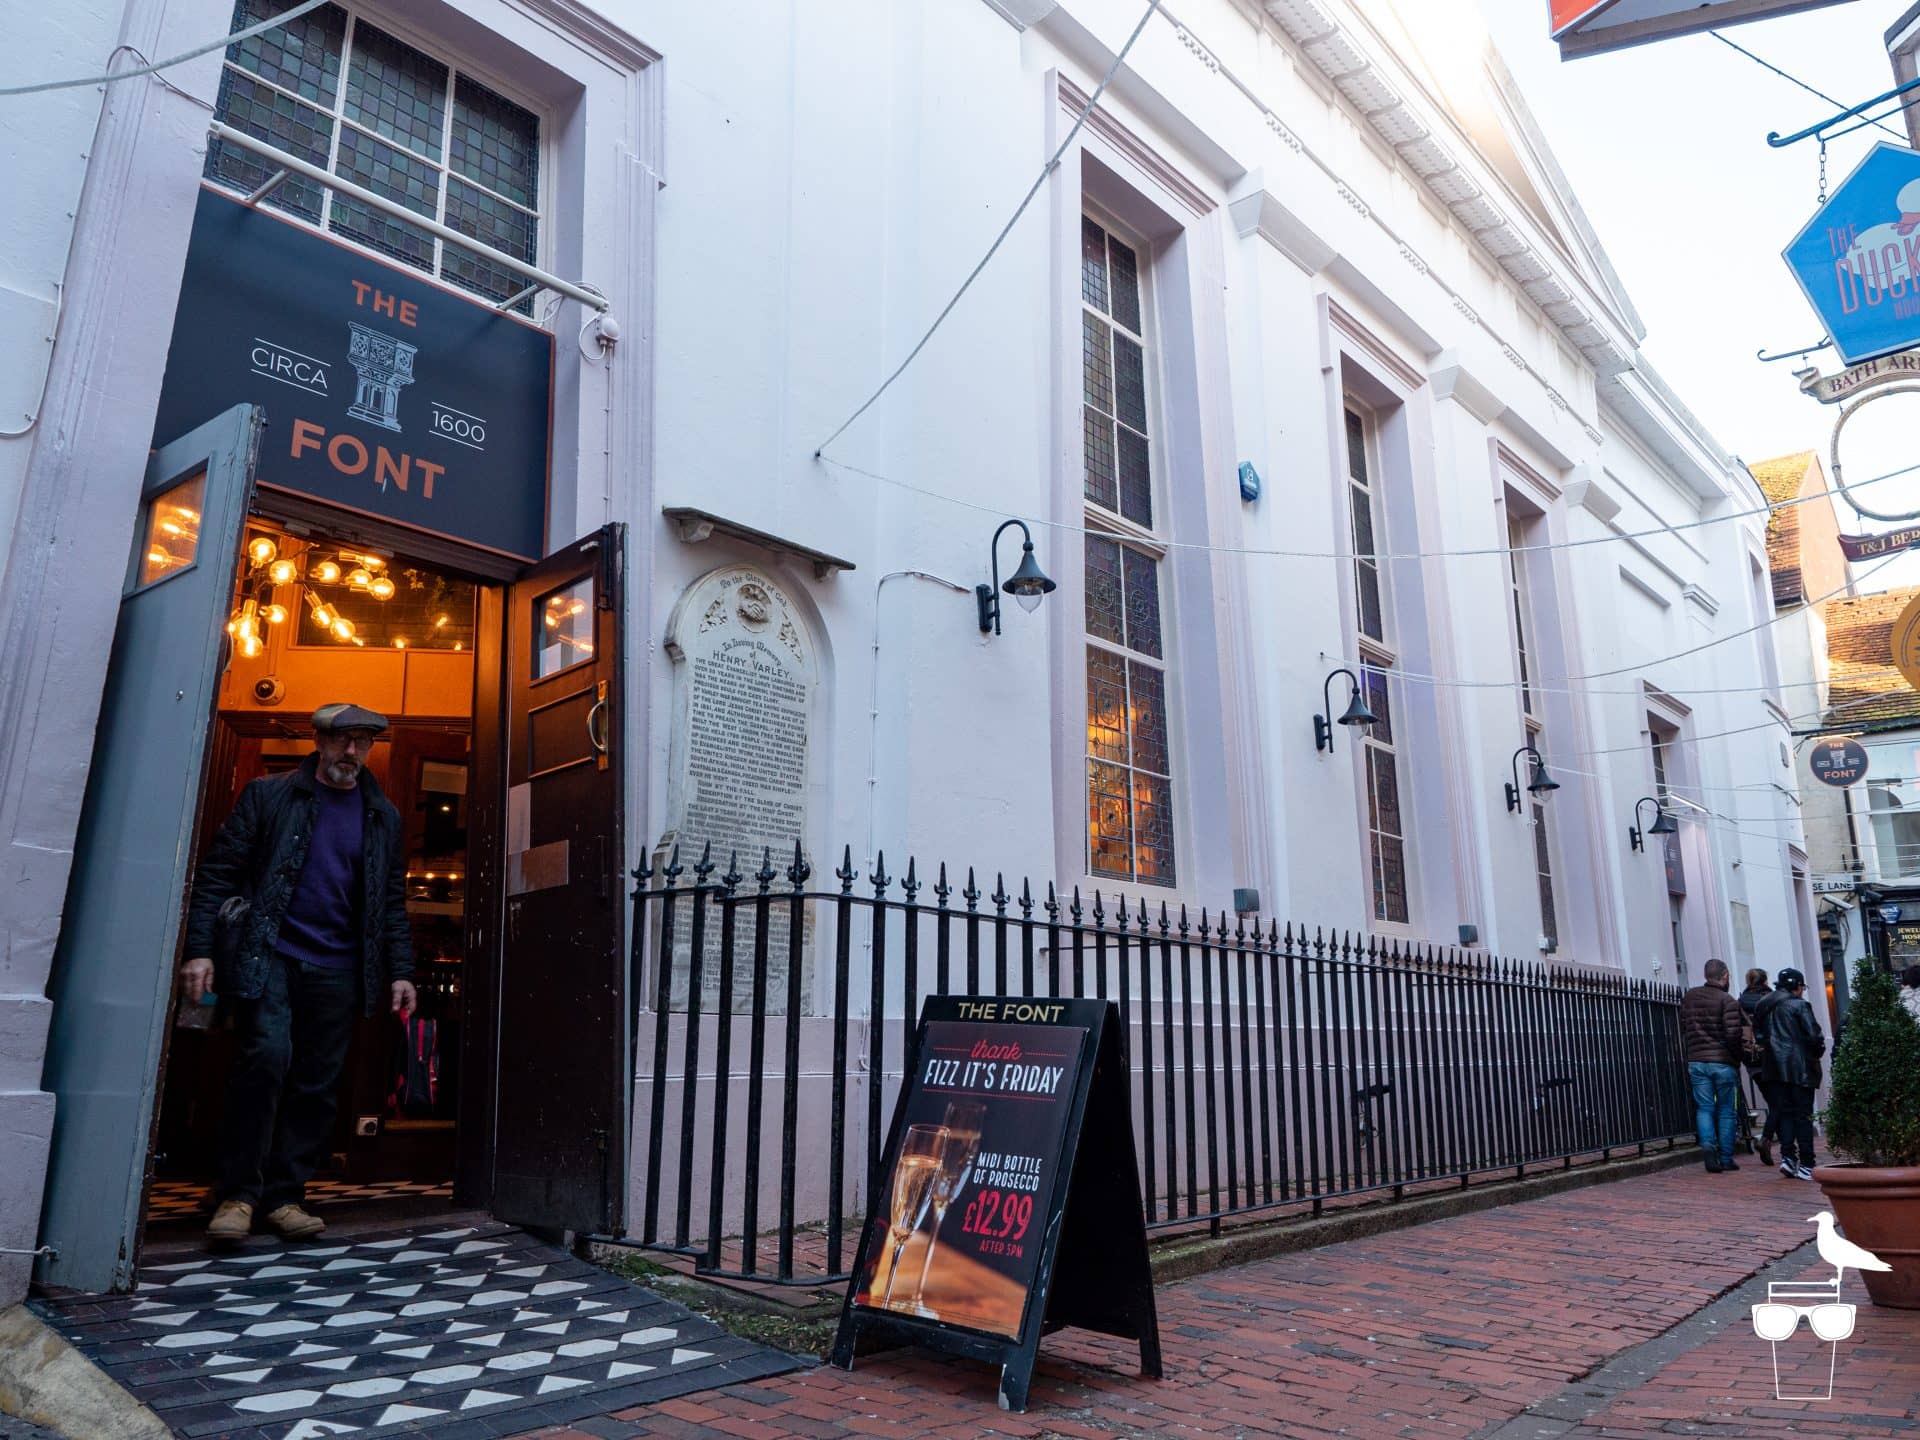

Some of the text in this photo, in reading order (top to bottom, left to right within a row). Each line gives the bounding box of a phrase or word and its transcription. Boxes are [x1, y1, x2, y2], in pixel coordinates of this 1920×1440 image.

[1826, 223, 1862, 256] THE
[351, 280, 418, 328] THE
[1831, 359, 1878, 392] BATH
[251, 346, 486, 443] CIRCA 1600
[290, 418, 446, 500] FONT
[1859, 538, 1885, 555] T&J
[713, 649, 747, 668] HENRY
[1824, 769, 1857, 780] FONT
[1828, 881, 1853, 890] LANE
[957, 1002, 1064, 1023] THE FONT
[970, 1039, 1022, 1061] thank
[924, 1059, 1064, 1095] FIZZ IT'S FRIDAY
[977, 1151, 1043, 1174] MIDI BOTTLE
[973, 1168, 1039, 1191] OF PROSECCO
[961, 1190, 1033, 1240] £12.99
[979, 1240, 1023, 1258] AFTER 5PM
